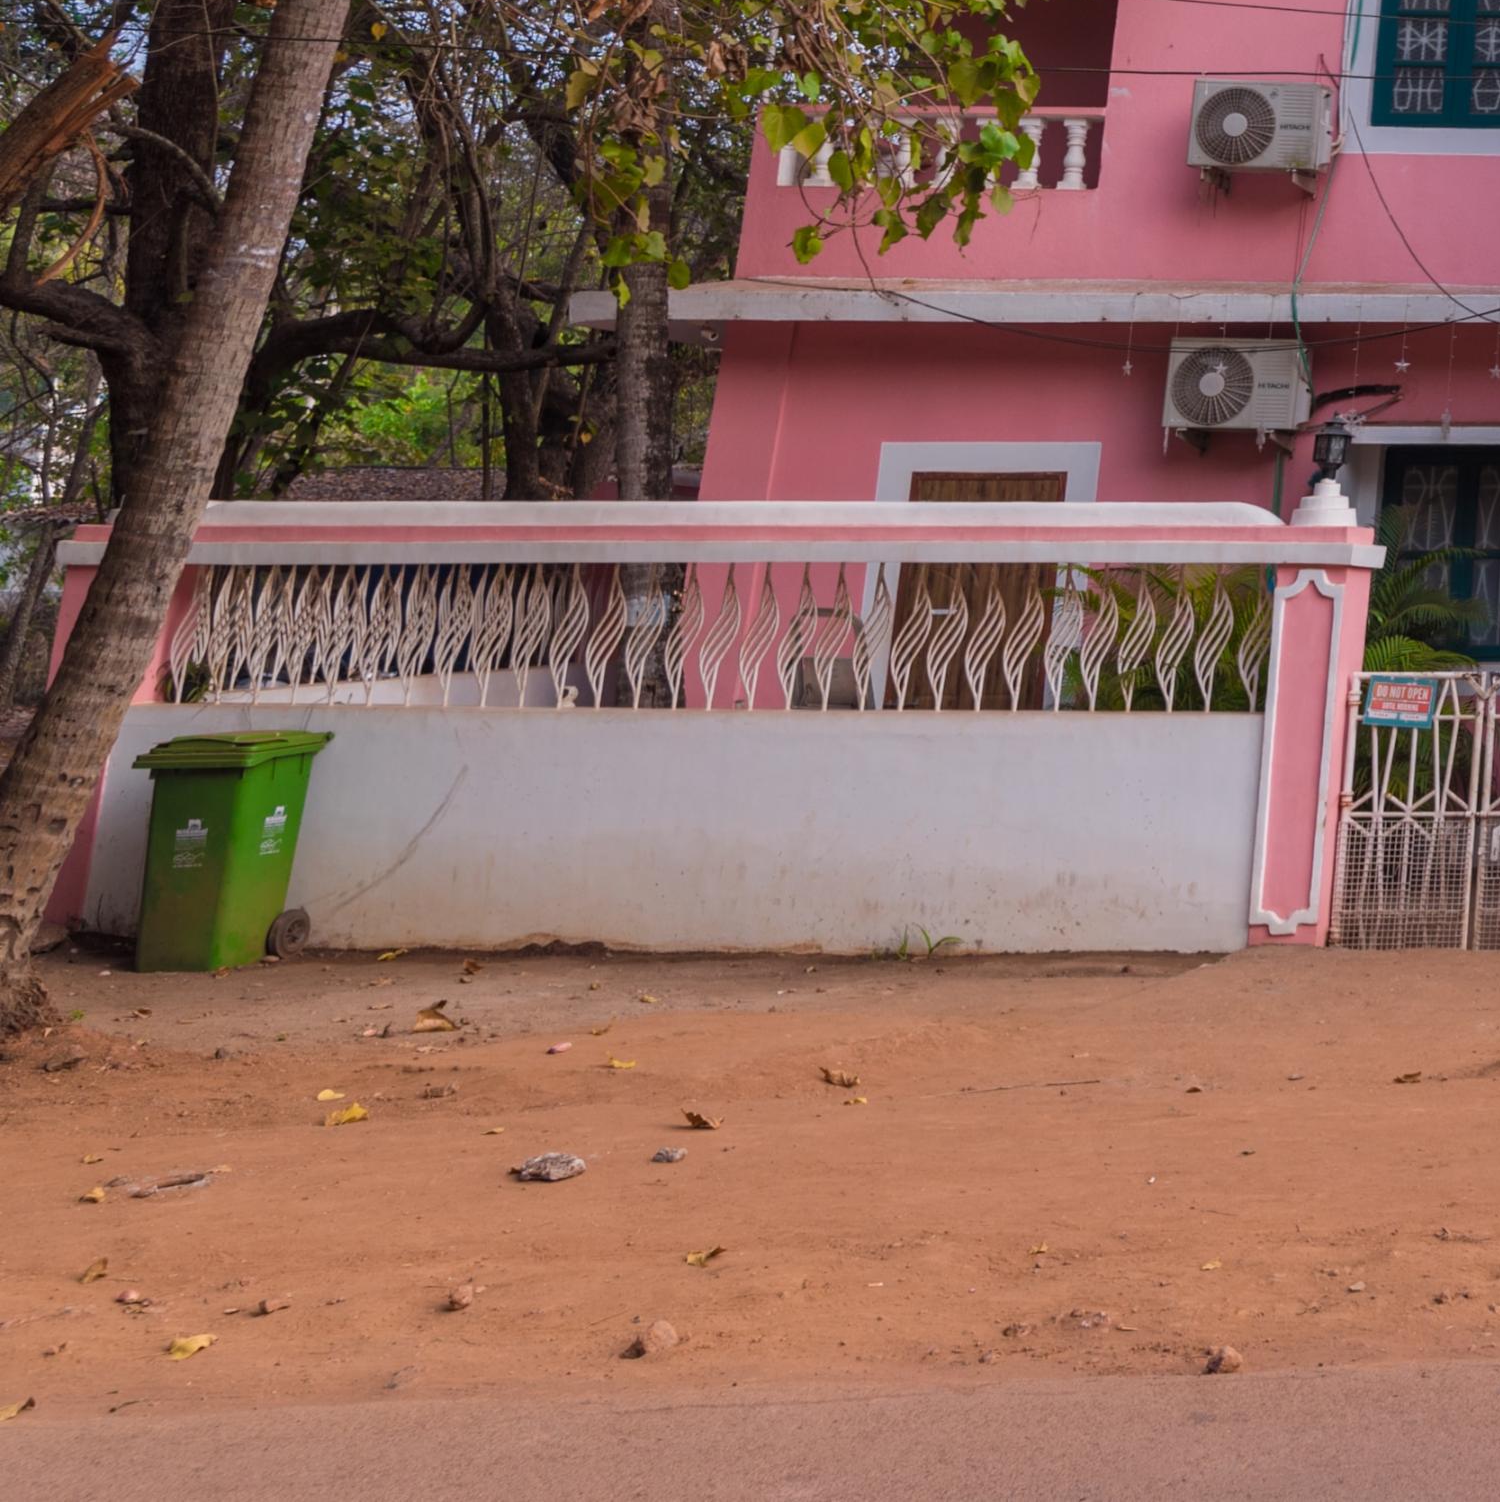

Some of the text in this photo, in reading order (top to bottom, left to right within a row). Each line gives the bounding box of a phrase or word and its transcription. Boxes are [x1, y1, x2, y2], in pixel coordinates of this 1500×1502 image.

[1279, 123, 1311, 131] HITACHI
[1375, 684, 1429, 701] DO NOT OPEN
